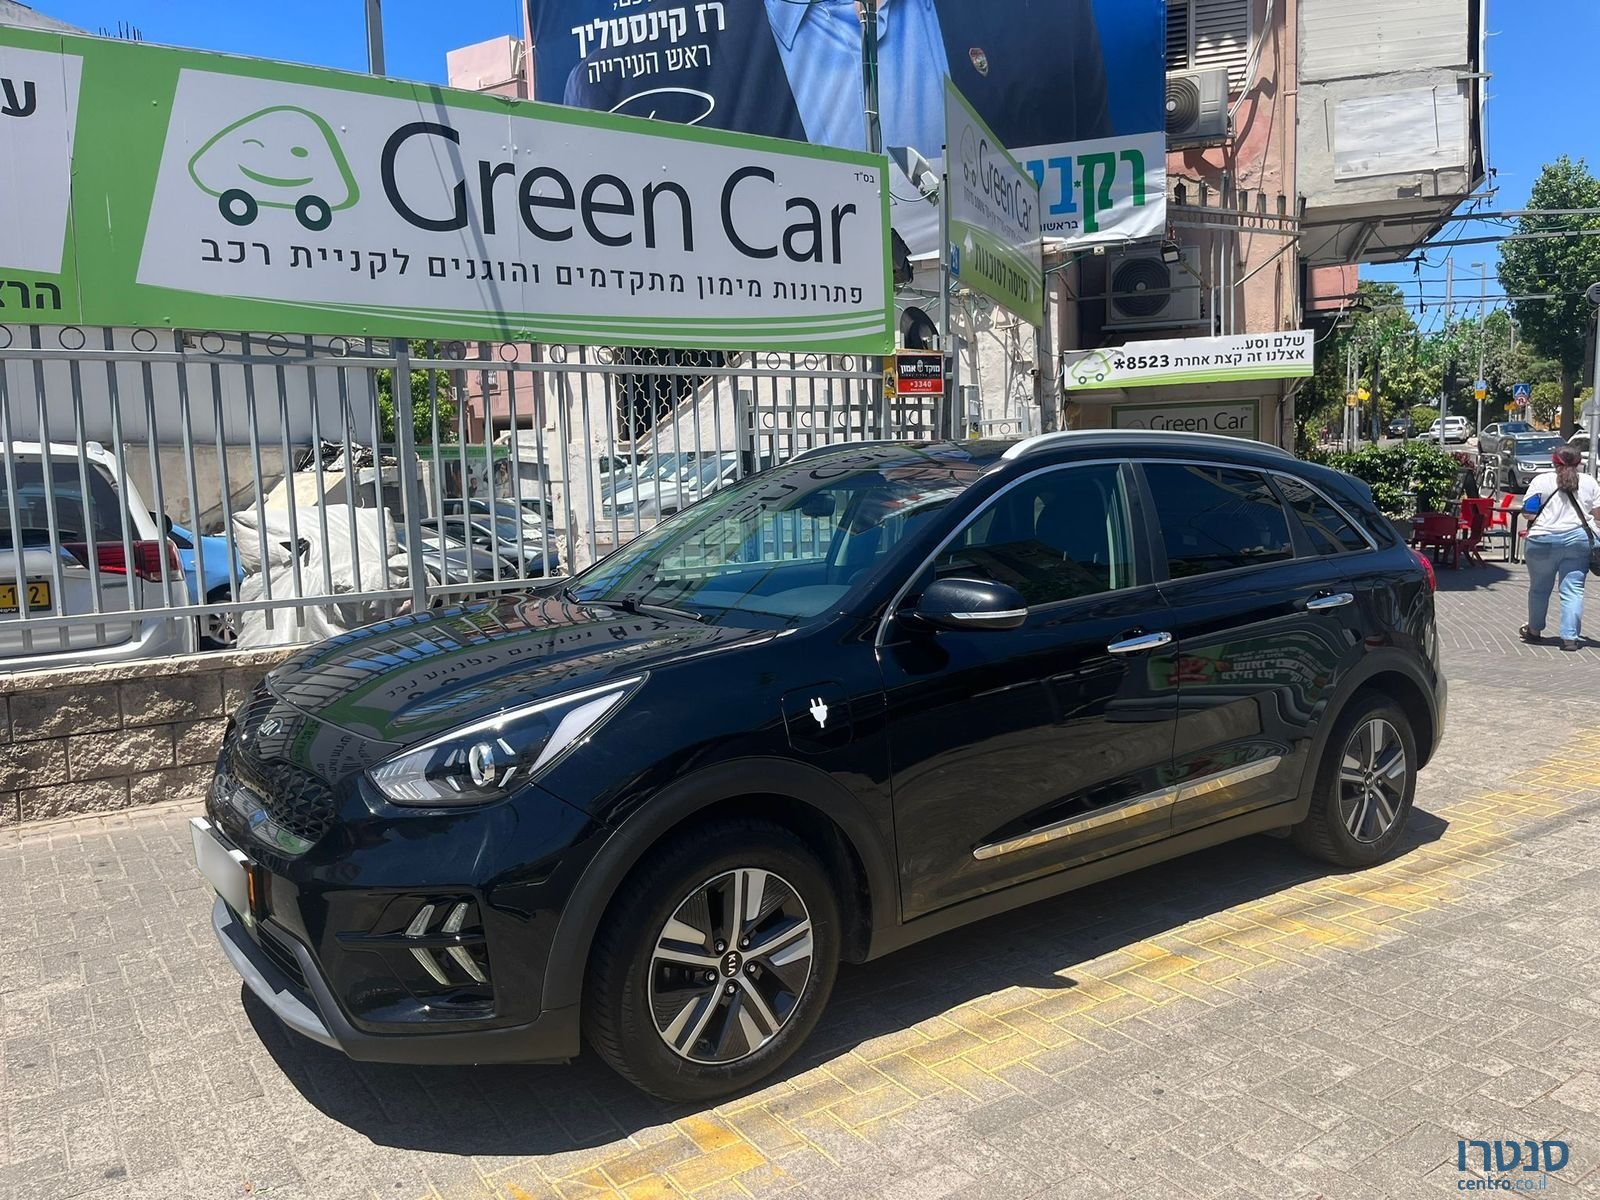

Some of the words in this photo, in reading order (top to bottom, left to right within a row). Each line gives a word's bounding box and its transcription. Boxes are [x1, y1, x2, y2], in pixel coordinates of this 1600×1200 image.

[695, 2, 725, 33] רז
[571, 7, 687, 59] קינסטליך
[588, 51, 659, 84] העירייה
[665, 44, 711, 71] ראש
[853, 171, 875, 184] בס"ד
[979, 138, 1014, 219] Green
[1015, 179, 1032, 232] Car
[380, 121, 694, 252] Green
[720, 165, 857, 264] Car
[1039, 219, 1079, 233] בראשו
[201, 238, 271, 265] רכב
[289, 243, 411, 280] לקניית
[427, 255, 541, 284] והוגנים
[974, 242, 1007, 289] לסוכנות
[556, 265, 685, 296] מתקדמים
[697, 275, 762, 300] מימון
[772, 280, 863, 304] פתרונות
[1008, 267, 1028, 303] כניסה
[0, 280, 61, 310] הר
[1231, 337, 1269, 350] וסע...
[1273, 335, 1306, 347] שלם
[1174, 355, 1210, 367] אחרת
[1214, 353, 1243, 366] קצת
[1247, 351, 1262, 362] זה
[1266, 349, 1306, 361] אצלנו
[1150, 415, 1208, 431] Green
[1213, 412, 1249, 430] Car
[727, 953, 736, 976] KIA
